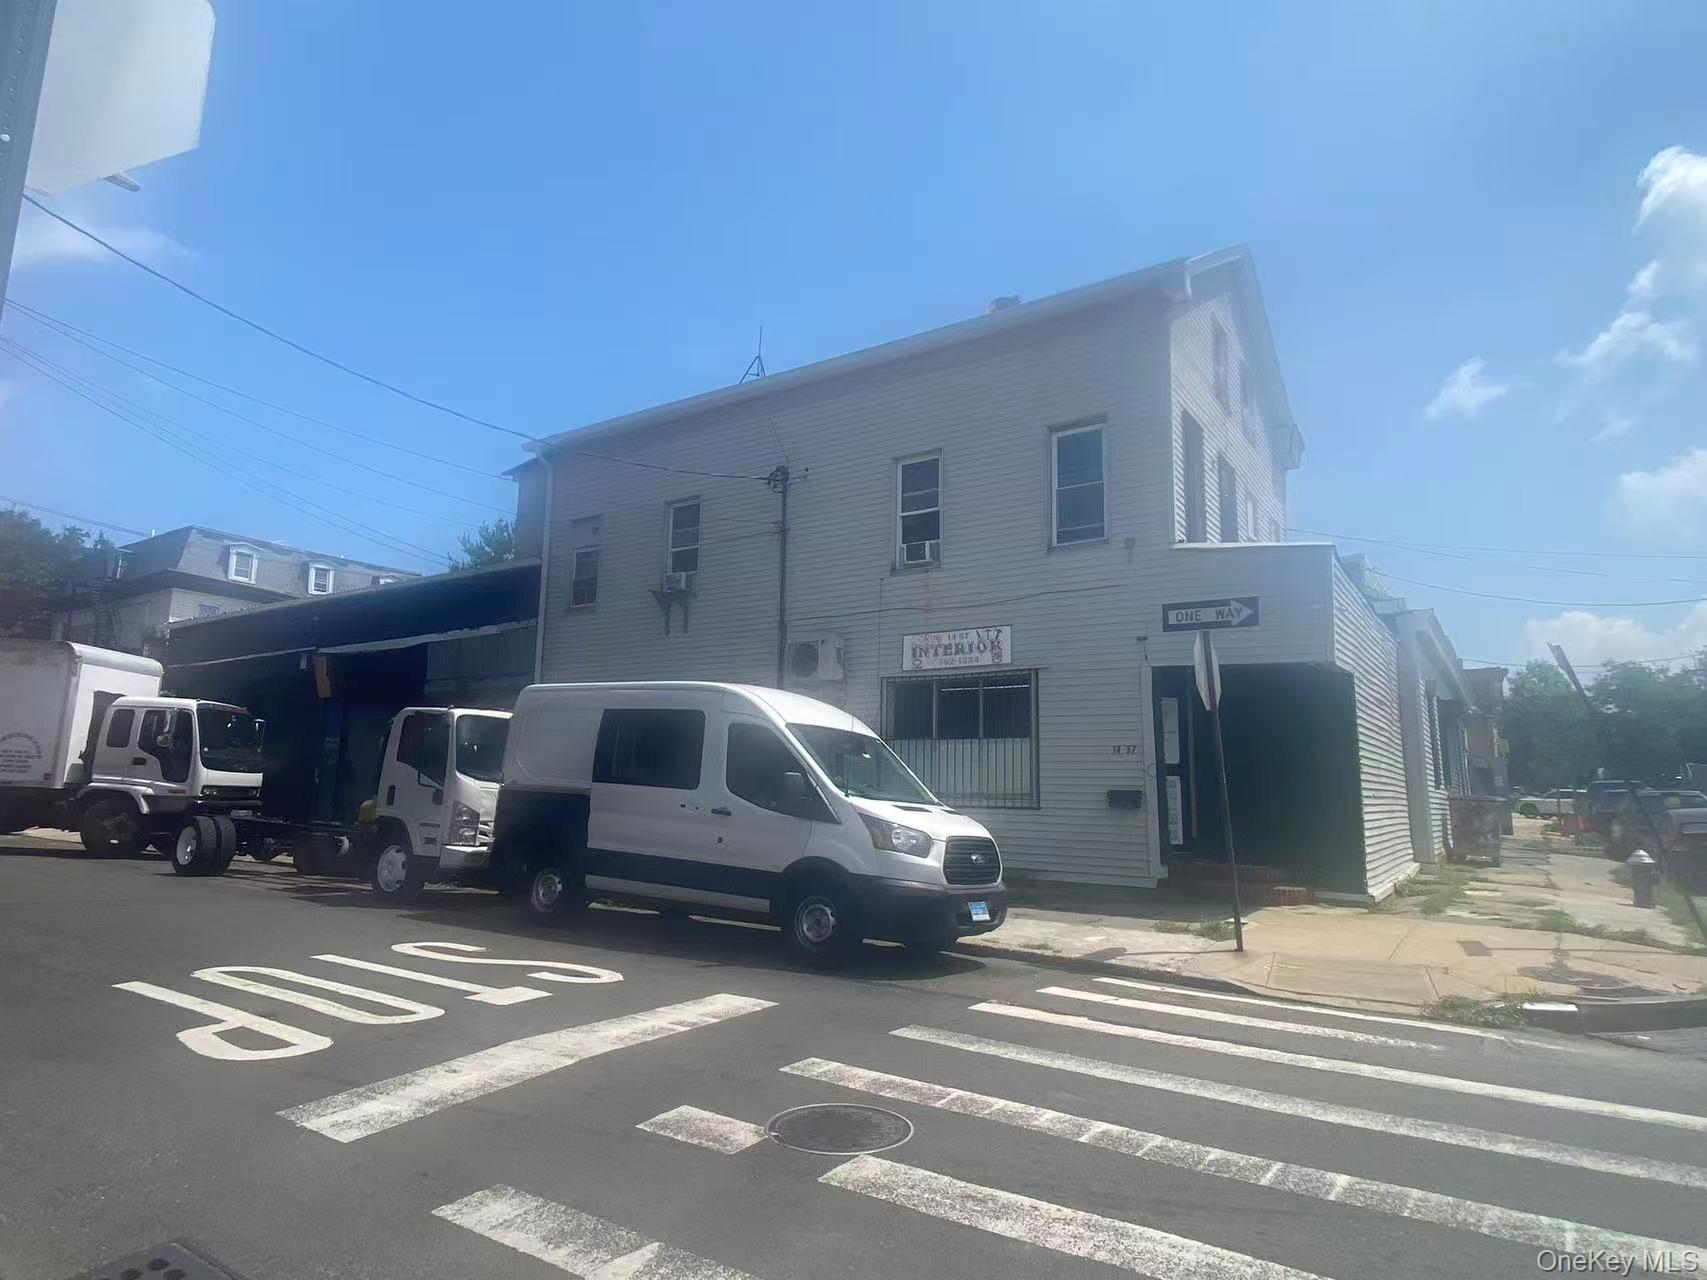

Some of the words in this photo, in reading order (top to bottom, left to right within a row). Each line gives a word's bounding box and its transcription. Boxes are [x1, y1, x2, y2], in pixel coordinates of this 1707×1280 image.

[1175, 609, 1203, 622] ONE
[1214, 606, 1243, 620] WAY
[911, 640, 1003, 658] INTERIOR
[112, 942, 623, 1060] STOP
